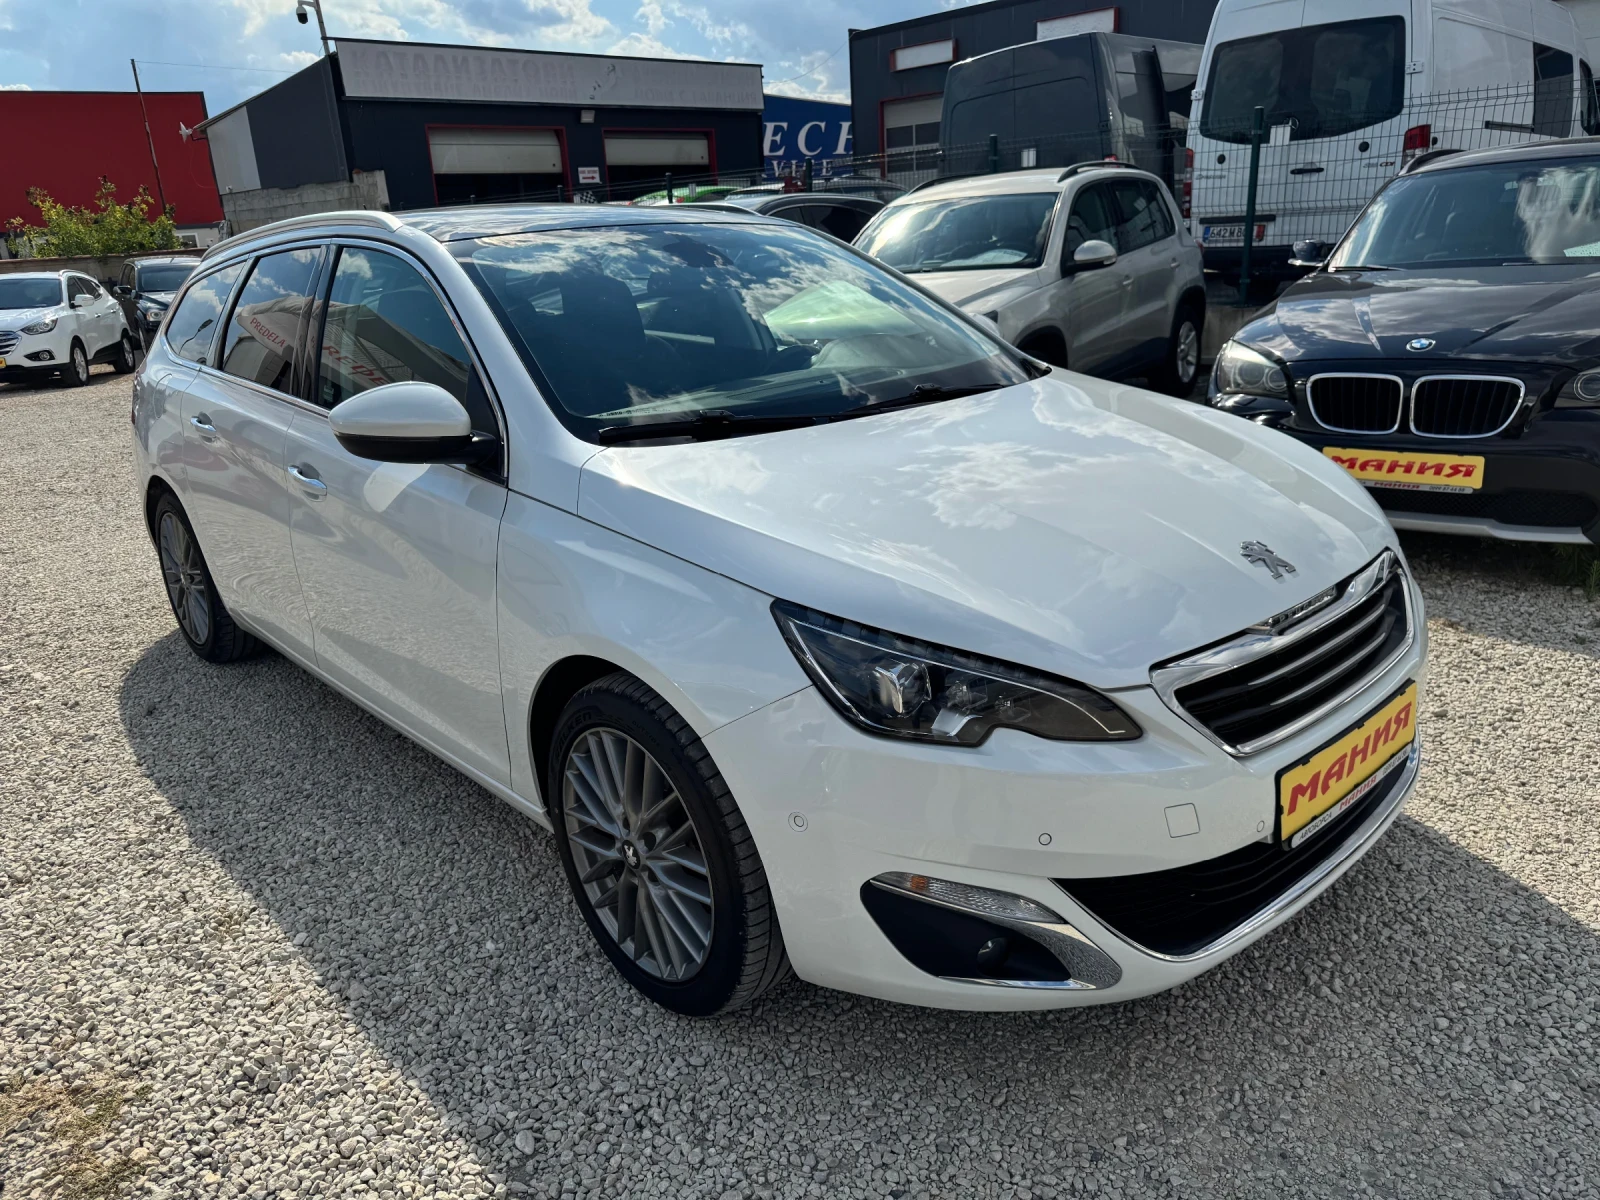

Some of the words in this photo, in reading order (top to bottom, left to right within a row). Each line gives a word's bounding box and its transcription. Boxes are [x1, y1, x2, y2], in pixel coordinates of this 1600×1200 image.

[250, 317, 286, 347] PREDELA
[1331, 456, 1477, 478] МАНИЯ
[1287, 701, 1412, 817] МАНИЯ
[1339, 774, 1377, 811] МАНИЯ
